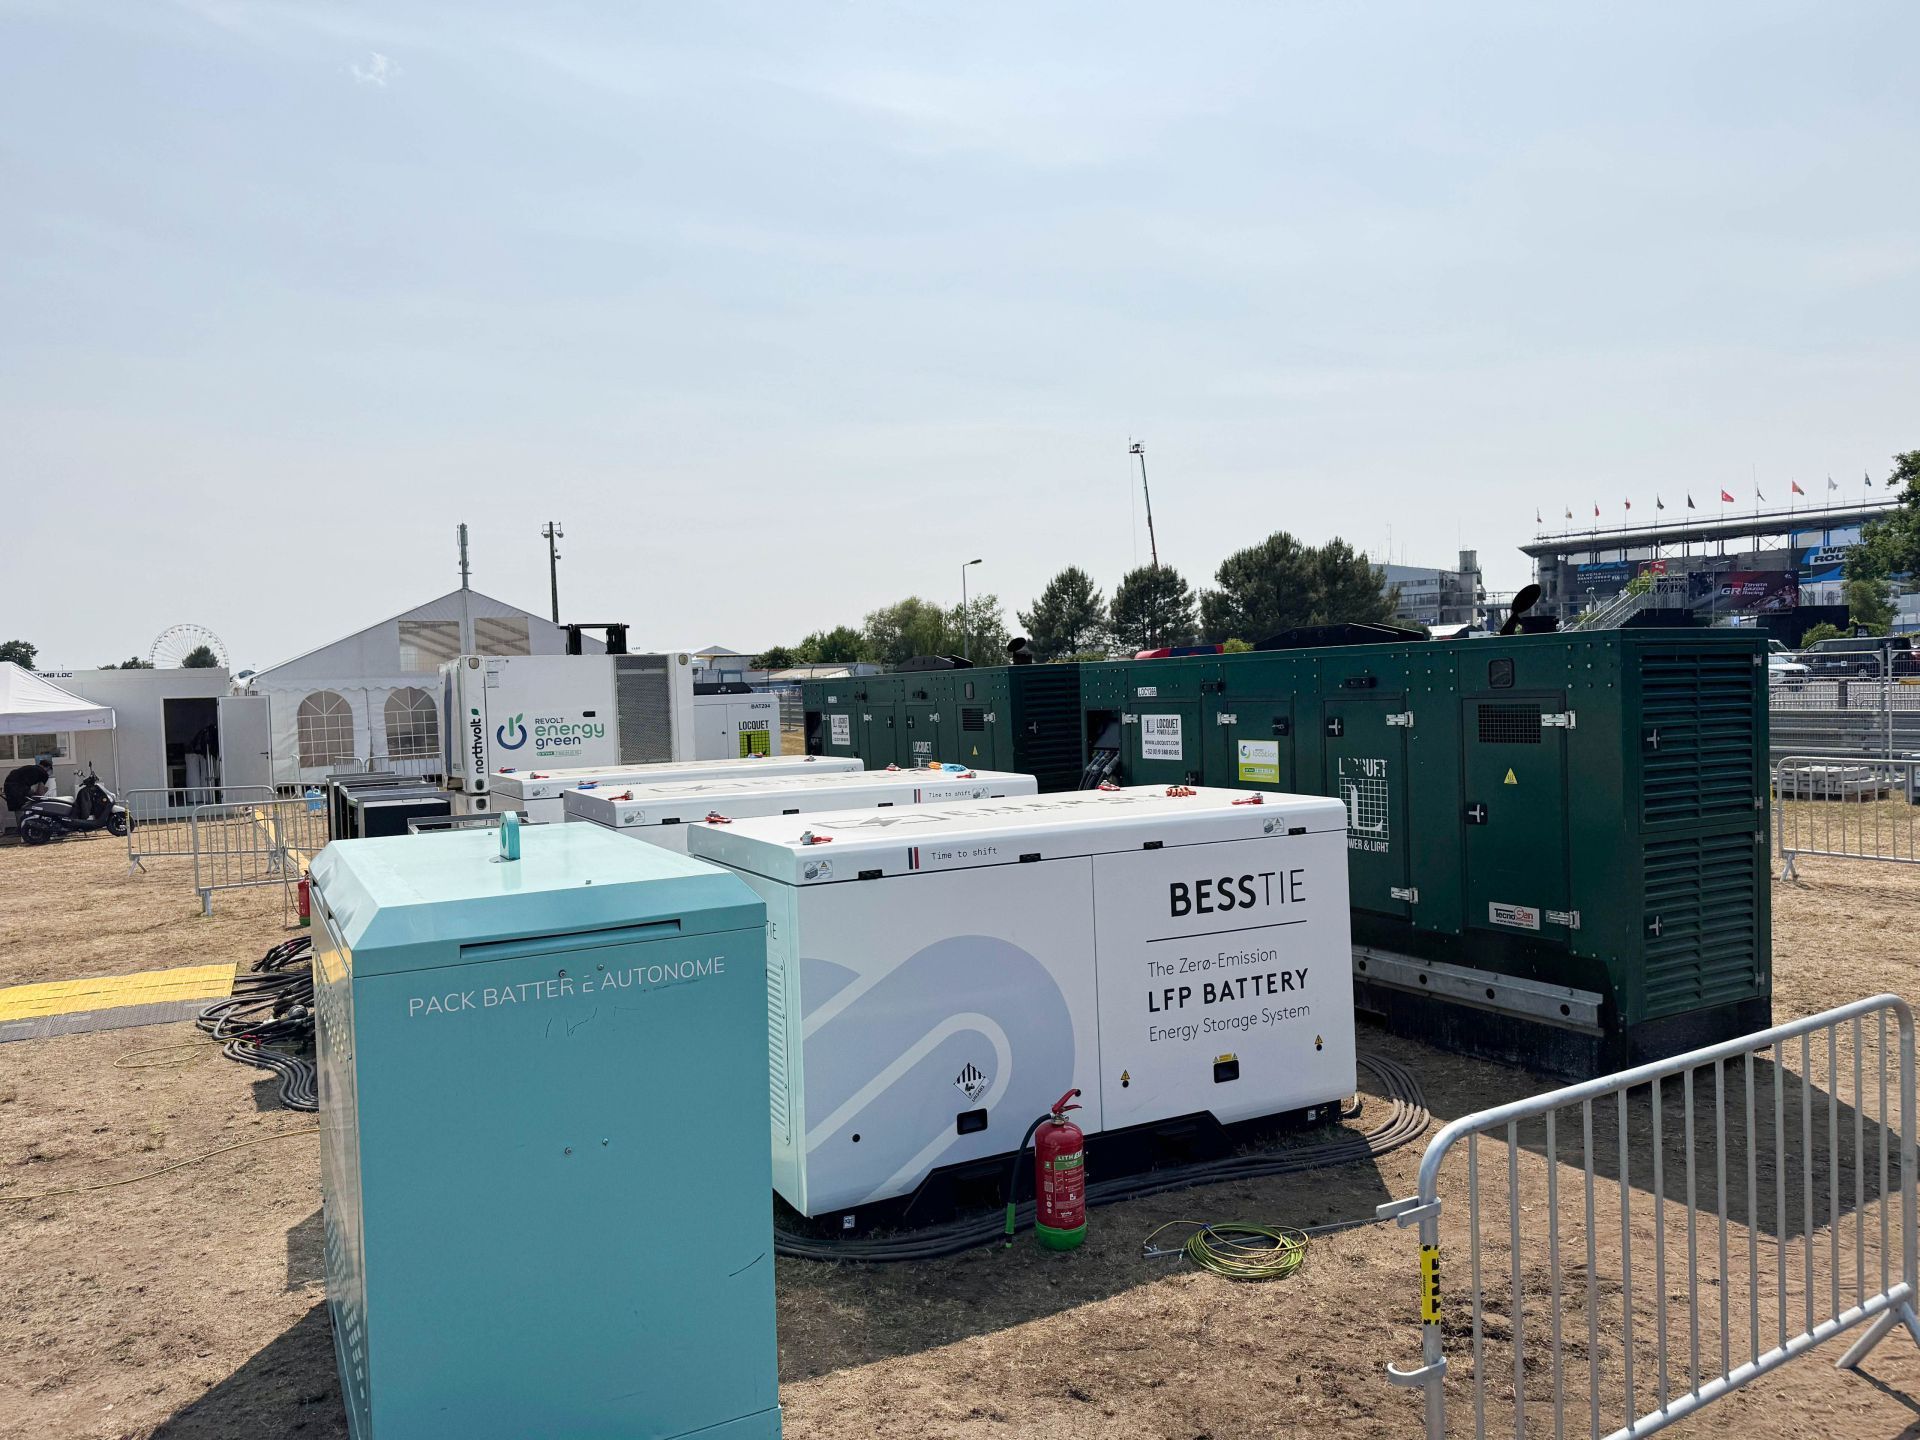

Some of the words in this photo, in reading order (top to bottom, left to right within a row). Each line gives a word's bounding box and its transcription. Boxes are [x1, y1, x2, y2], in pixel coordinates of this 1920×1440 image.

[1721, 587, 1741, 595] GR
[535, 717, 564, 725] REVOLT
[738, 720, 770, 731] LOCQUET
[1156, 718, 1179, 729] LOCQUET
[535, 723, 605, 739] energy
[470, 717, 484, 774] northvolt
[536, 736, 581, 750] green
[1363, 839, 1370, 851] &
[1370, 840, 1390, 853] LIGHT
[931, 851, 952, 861] Time
[958, 850, 968, 858] to
[972, 847, 998, 857] shift
[1169, 867, 1307, 918] BESSTIE
[1147, 961, 1175, 978] The
[408, 990, 477, 1018] PACK
[482, 974, 595, 1008] BATTERE
[600, 955, 726, 991] AUTONOME
[1147, 985, 1192, 1013] LFP
[1203, 967, 1309, 1005] BATTERY
[1149, 1021, 1199, 1042] Energy
[1203, 1011, 1258, 1034] Storage
[1261, 1003, 1311, 1026] System
